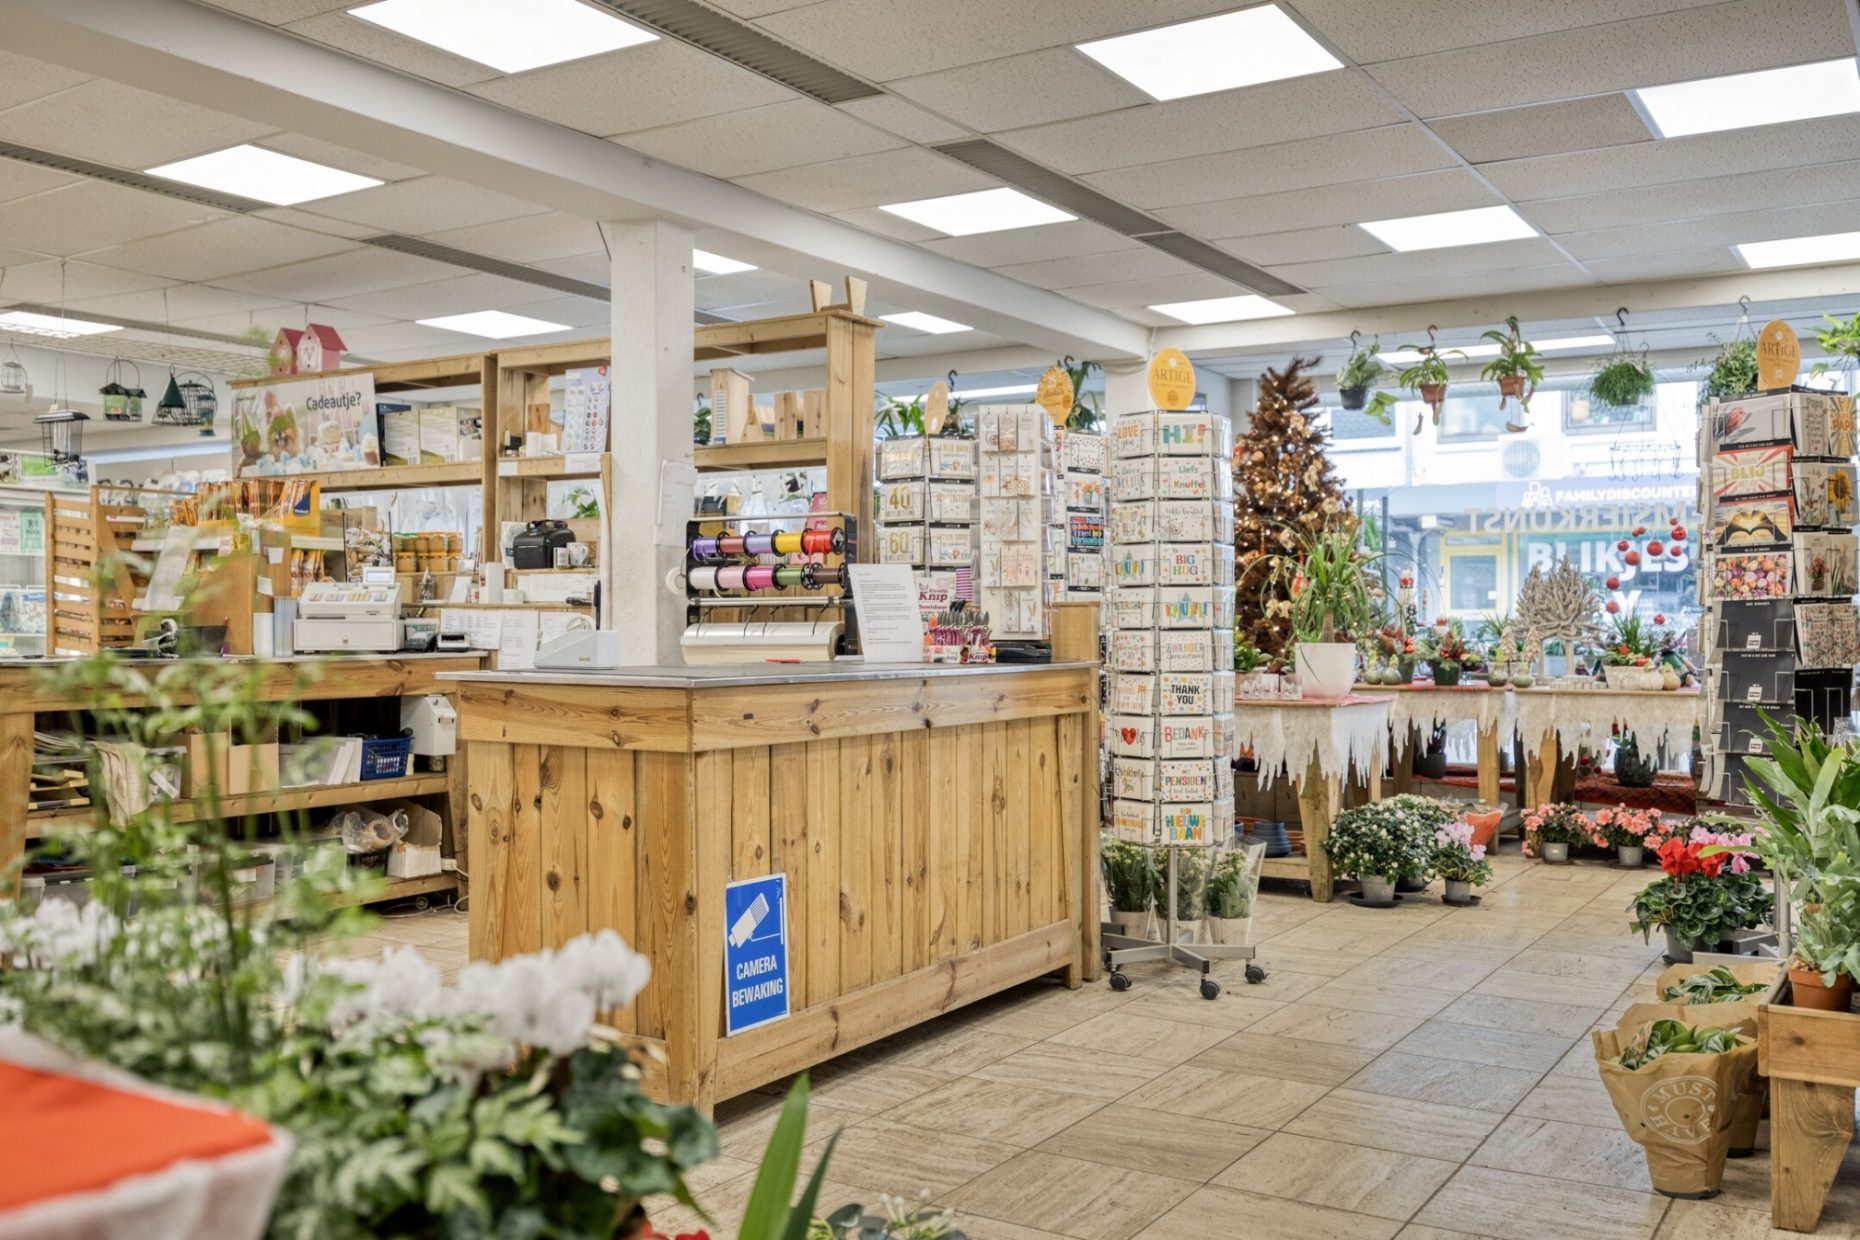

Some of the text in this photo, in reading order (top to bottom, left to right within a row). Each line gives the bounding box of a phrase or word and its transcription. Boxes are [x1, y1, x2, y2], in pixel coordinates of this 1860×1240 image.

[306, 391, 362, 411] Cadeautje?
[1162, 424, 1207, 444] HI!
[1178, 464, 1199, 474] Liefs
[1173, 479, 1206, 489] Knuffel
[889, 485, 911, 510] 40
[889, 532, 909, 554] 60
[1175, 555, 1196, 564] BIG
[1173, 566, 1198, 575] HUG
[918, 591, 948, 602] Knip
[1171, 685, 1200, 694] THANK
[1176, 695, 1194, 704] YOU
[1170, 827, 1202, 840] BAAN
[736, 954, 778, 980] CAMERA
[732, 978, 783, 1008] BEWAKING
[1652, 1082, 1716, 1105] MUST
